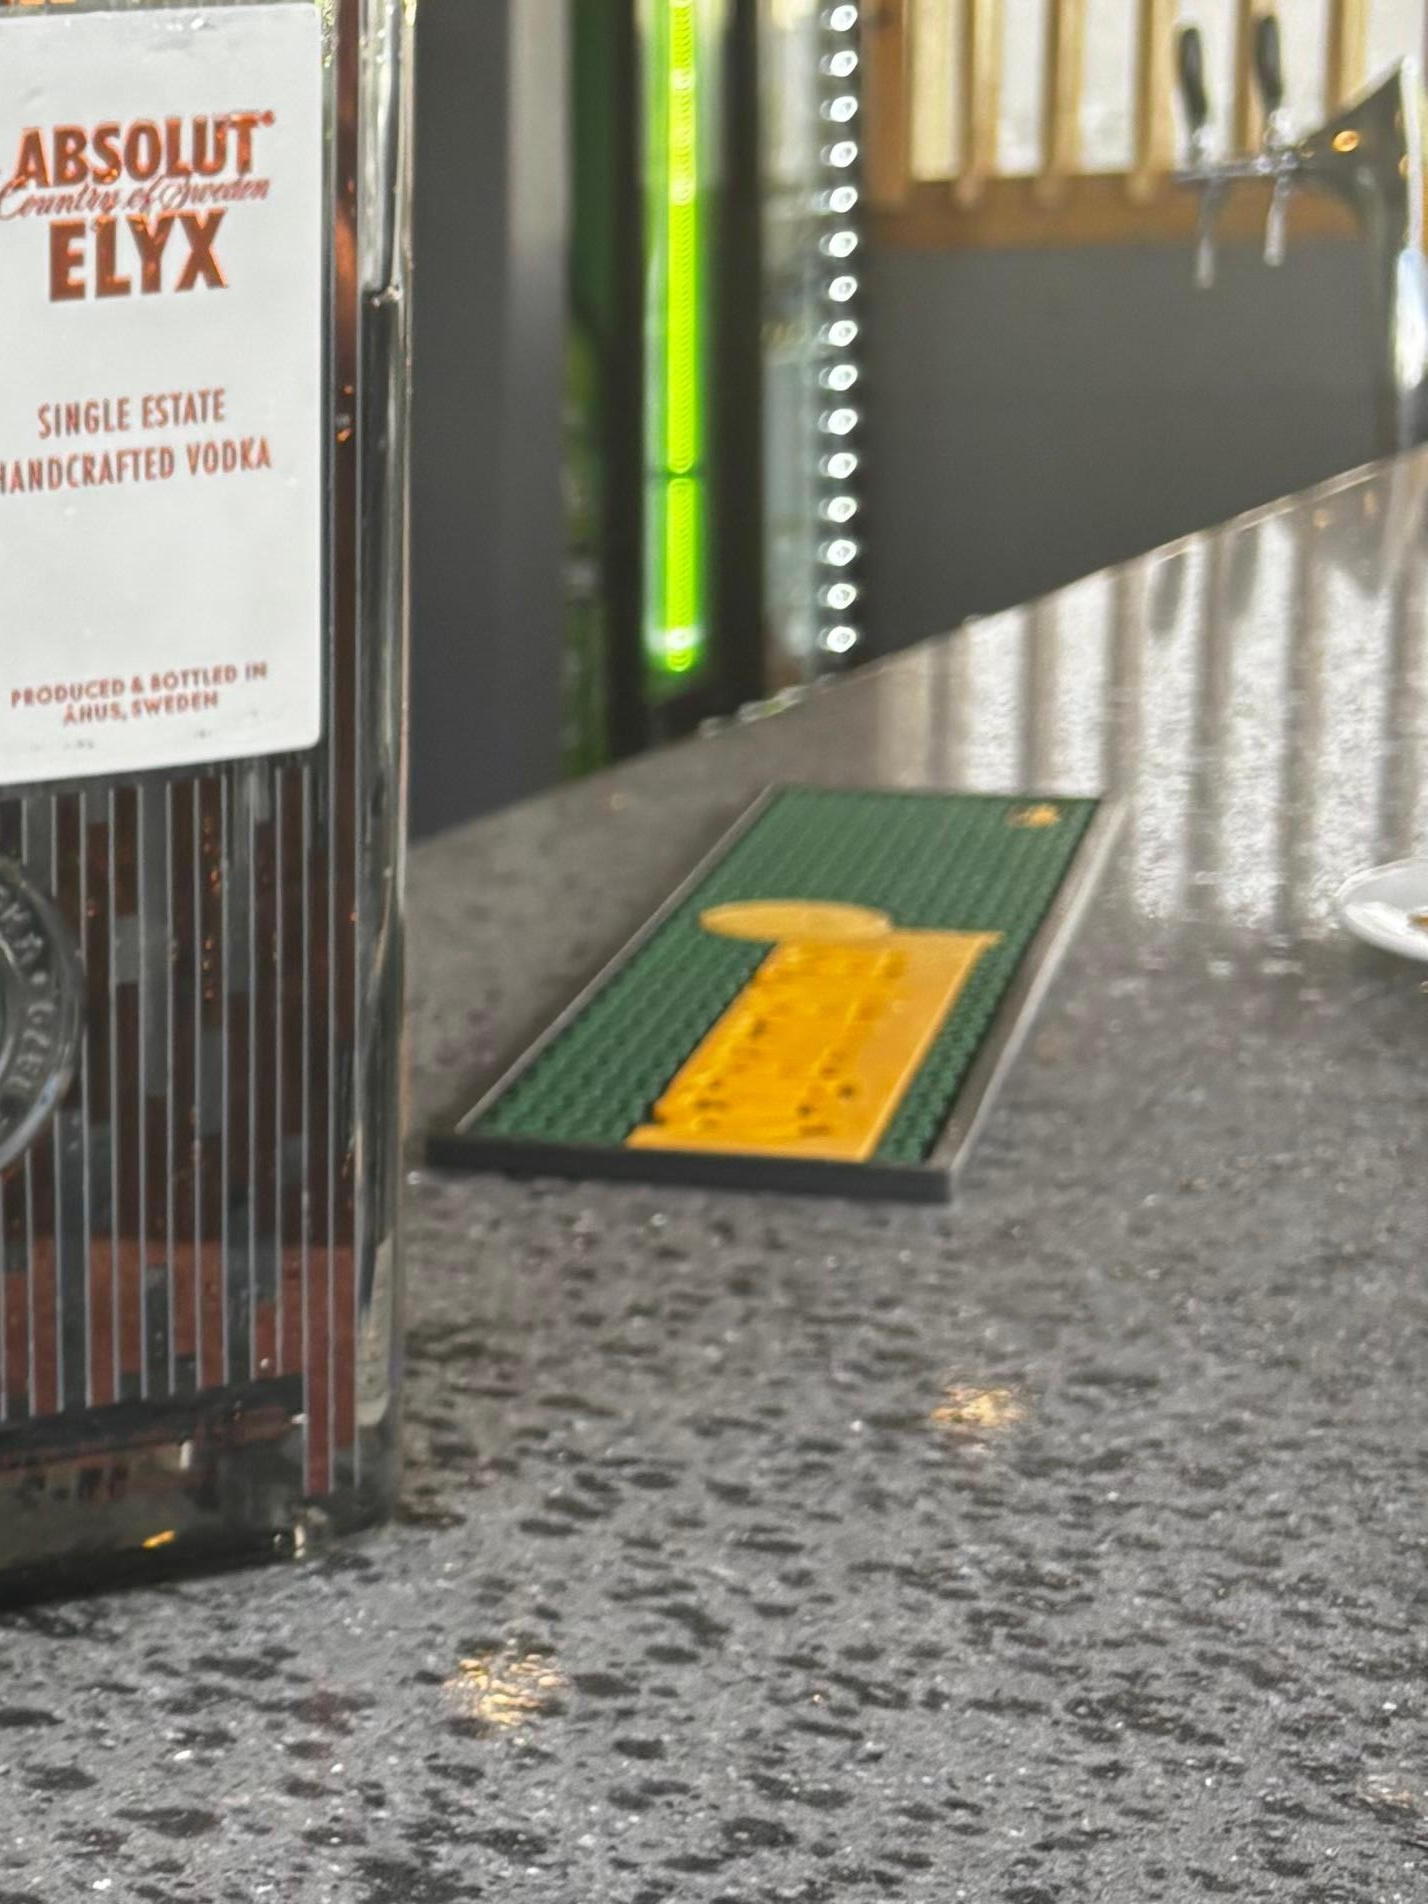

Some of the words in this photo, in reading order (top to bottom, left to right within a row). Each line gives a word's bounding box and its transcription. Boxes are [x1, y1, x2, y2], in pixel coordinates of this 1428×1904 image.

[16, 110, 262, 190] ABSOLUT
[157, 177, 271, 209] Sweden
[49, 207, 229, 302] ELYX
[37, 397, 131, 440] SINGLE
[141, 387, 226, 429] ESTATE
[186, 435, 272, 477] VODKA
[10, 678, 125, 709] PRODUCED
[130, 674, 145, 695] &
[150, 663, 238, 693] BOTTLED
[245, 661, 268, 682] IN
[131, 690, 219, 718] SWEDEN
